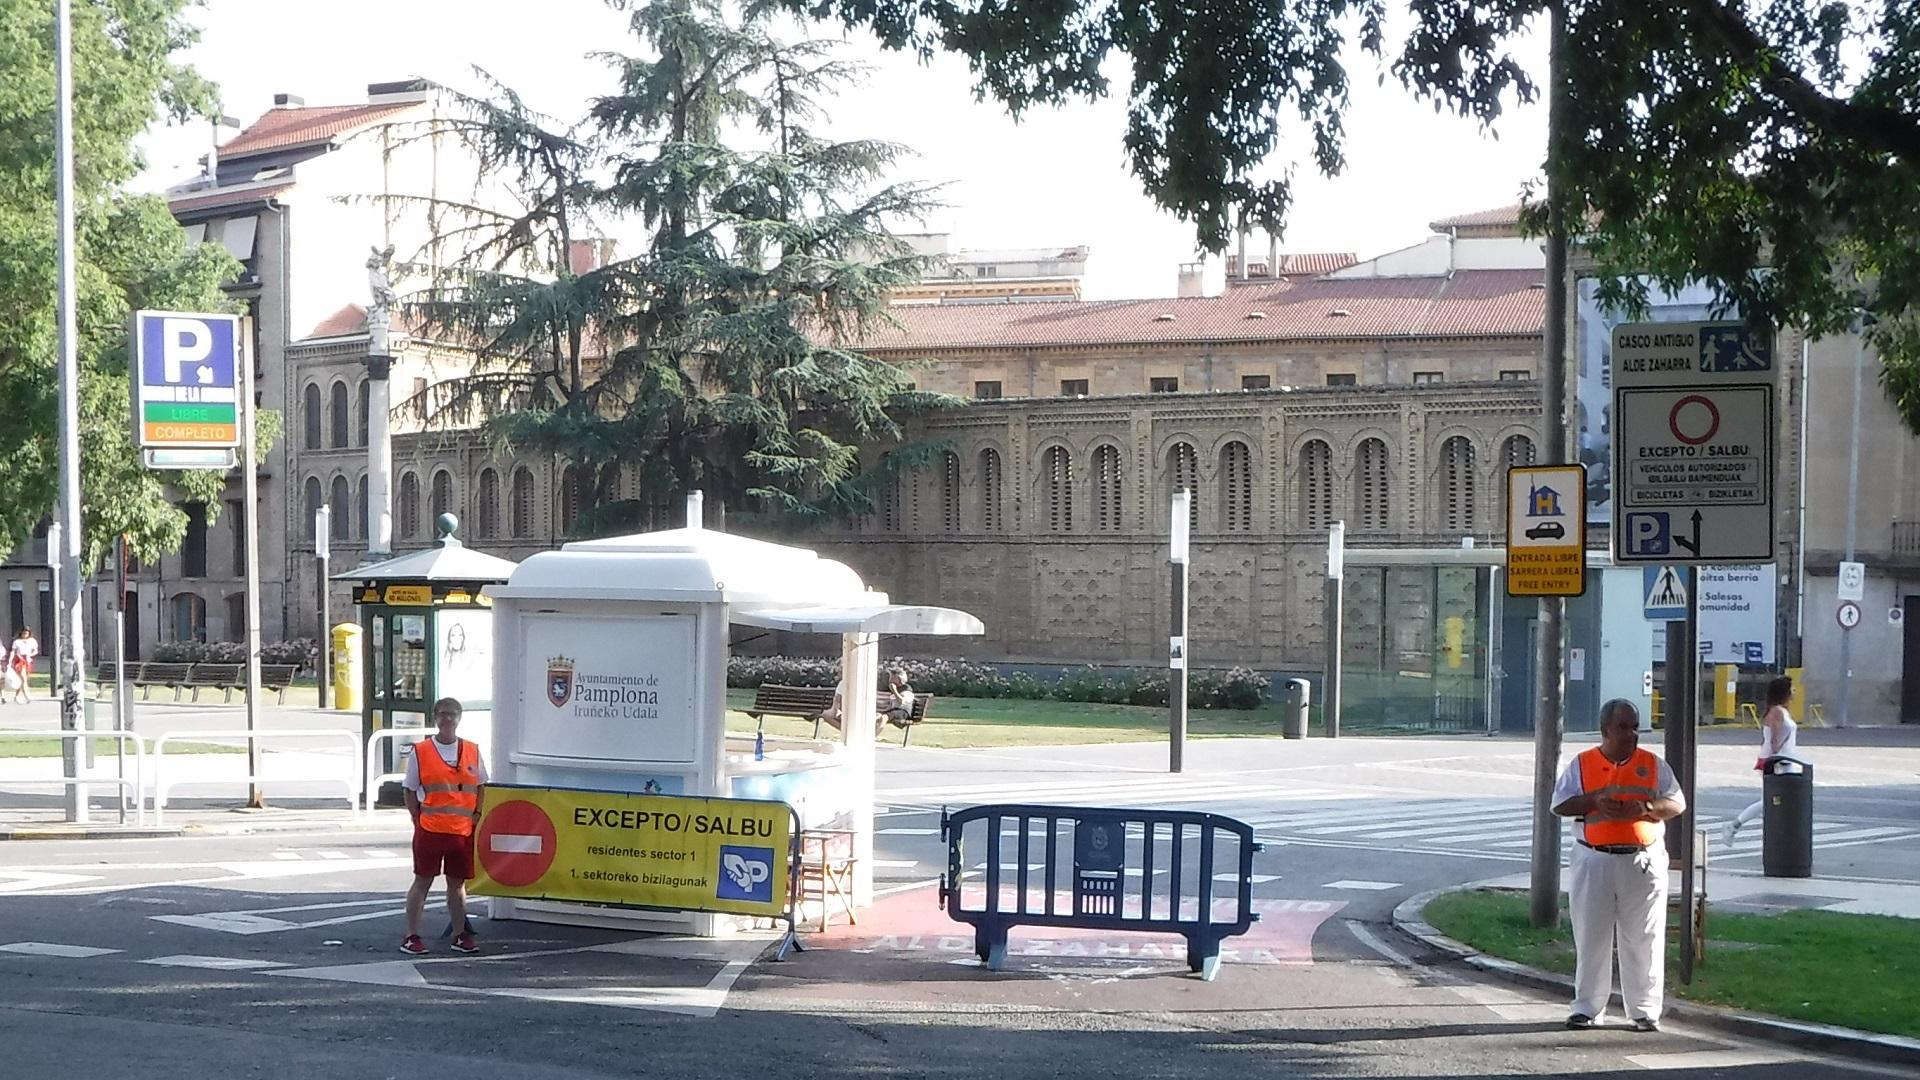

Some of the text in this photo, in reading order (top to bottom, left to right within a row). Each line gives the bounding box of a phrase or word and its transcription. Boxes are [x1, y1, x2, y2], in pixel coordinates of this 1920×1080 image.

[1619, 334, 1694, 349] CASCO ANTIGUO
[163, 318, 213, 383] P
[1623, 358, 1692, 372] ALDE ZAHARRA
[171, 408, 208, 421] LIBRE
[155, 426, 225, 440] COMPLETO
[1639, 446, 1696, 457] EXCEPTO
[1688, 463, 1746, 472] AUTORIZADOS
[1637, 491, 1684, 499] BICICLETAS
[1632, 515, 1660, 552] P
[1511, 553, 1578, 562] ENTRADA LIBRE
[1510, 567, 1579, 576] SARRERA LIBREA
[1518, 580, 1569, 589] FREE ENTRY
[1705, 591, 1743, 601] Salesas
[1699, 602, 1750, 611] omunidad
[576, 672, 659, 687] Ayuntamiento de
[575, 684, 659, 707] Pamplona
[574, 705, 658, 719] Iruñeko Udala
[587, 845, 696, 861] residentes sector 1
[570, 868, 709, 888] 1. sektoreko bizilagunak
[871, 934, 973, 951] ALD
